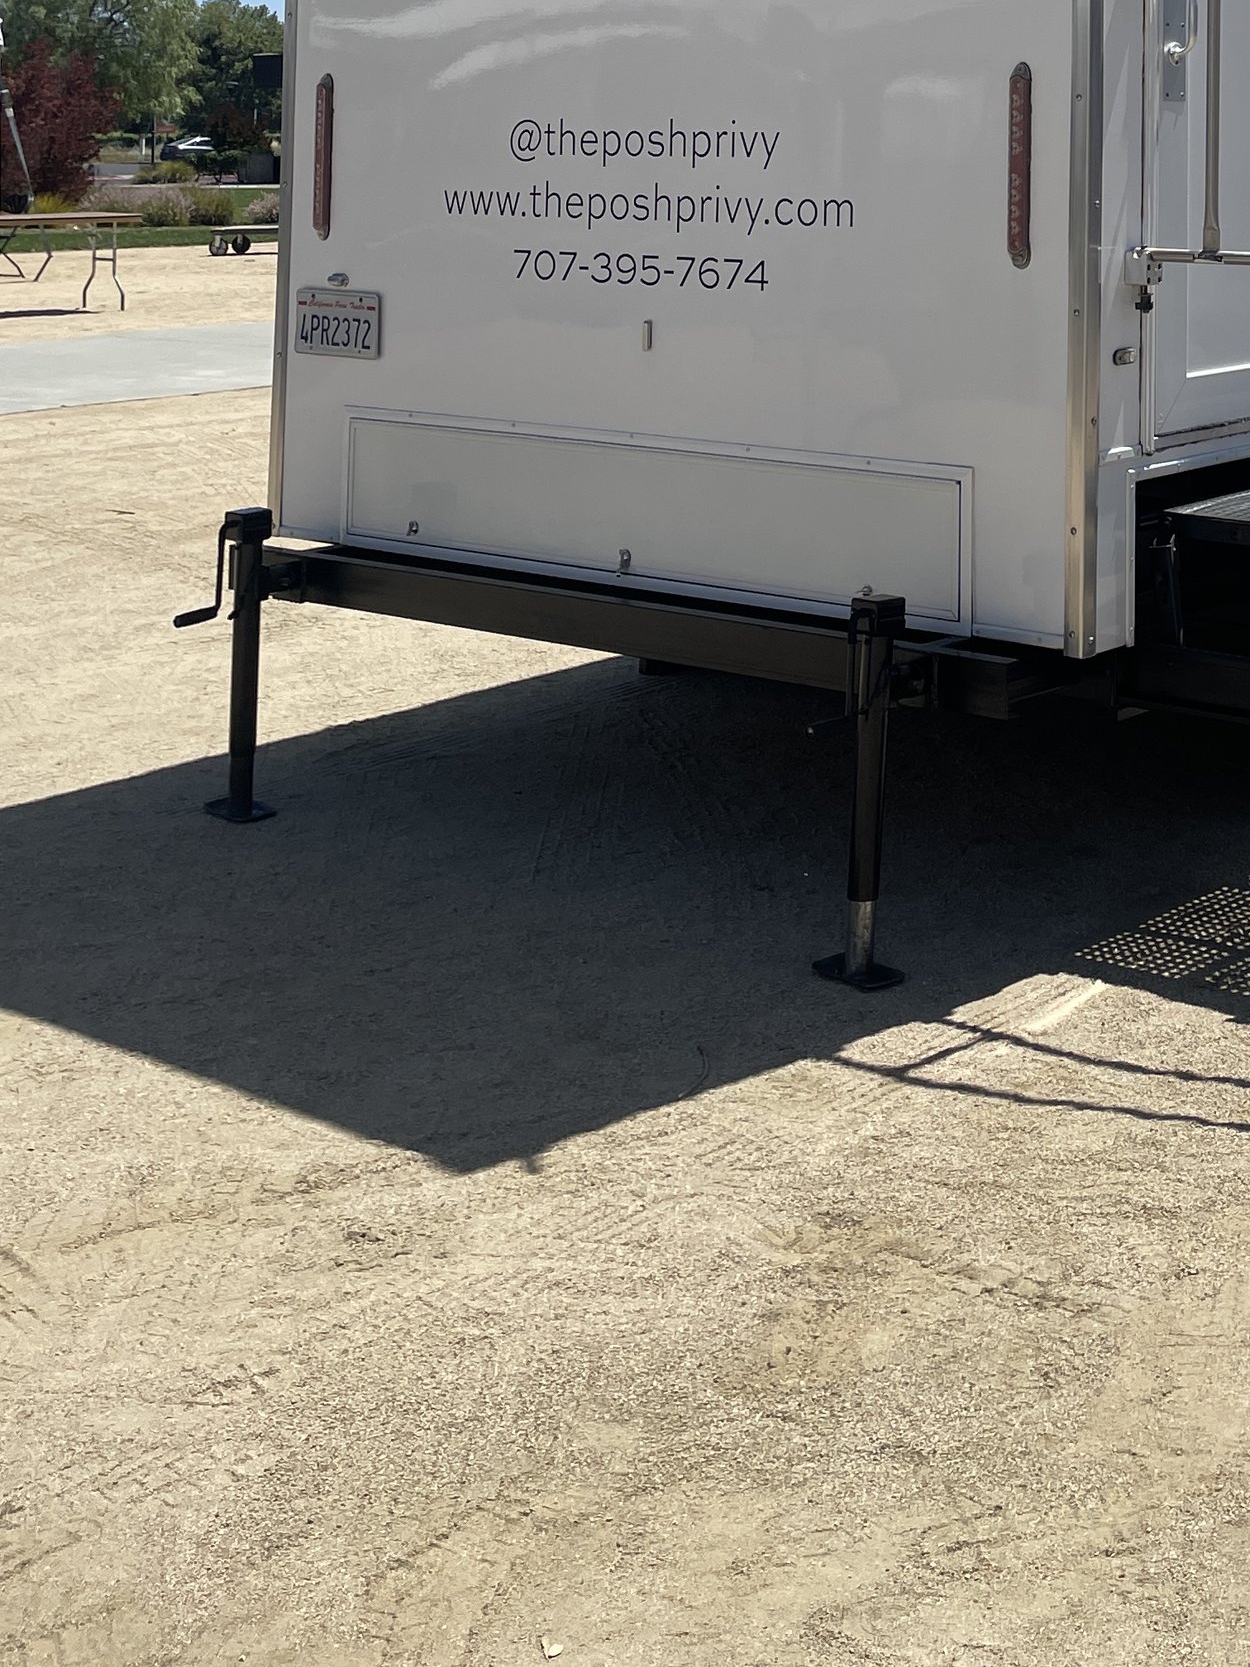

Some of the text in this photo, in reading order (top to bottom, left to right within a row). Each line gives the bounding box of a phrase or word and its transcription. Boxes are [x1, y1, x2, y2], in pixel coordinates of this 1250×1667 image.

[510, 118, 780, 170] @theposhprivy
[444, 181, 854, 236] www.theposhprivy.com
[514, 249, 769, 292] 707-395-7674
[300, 313, 371, 350] 4PR2372
